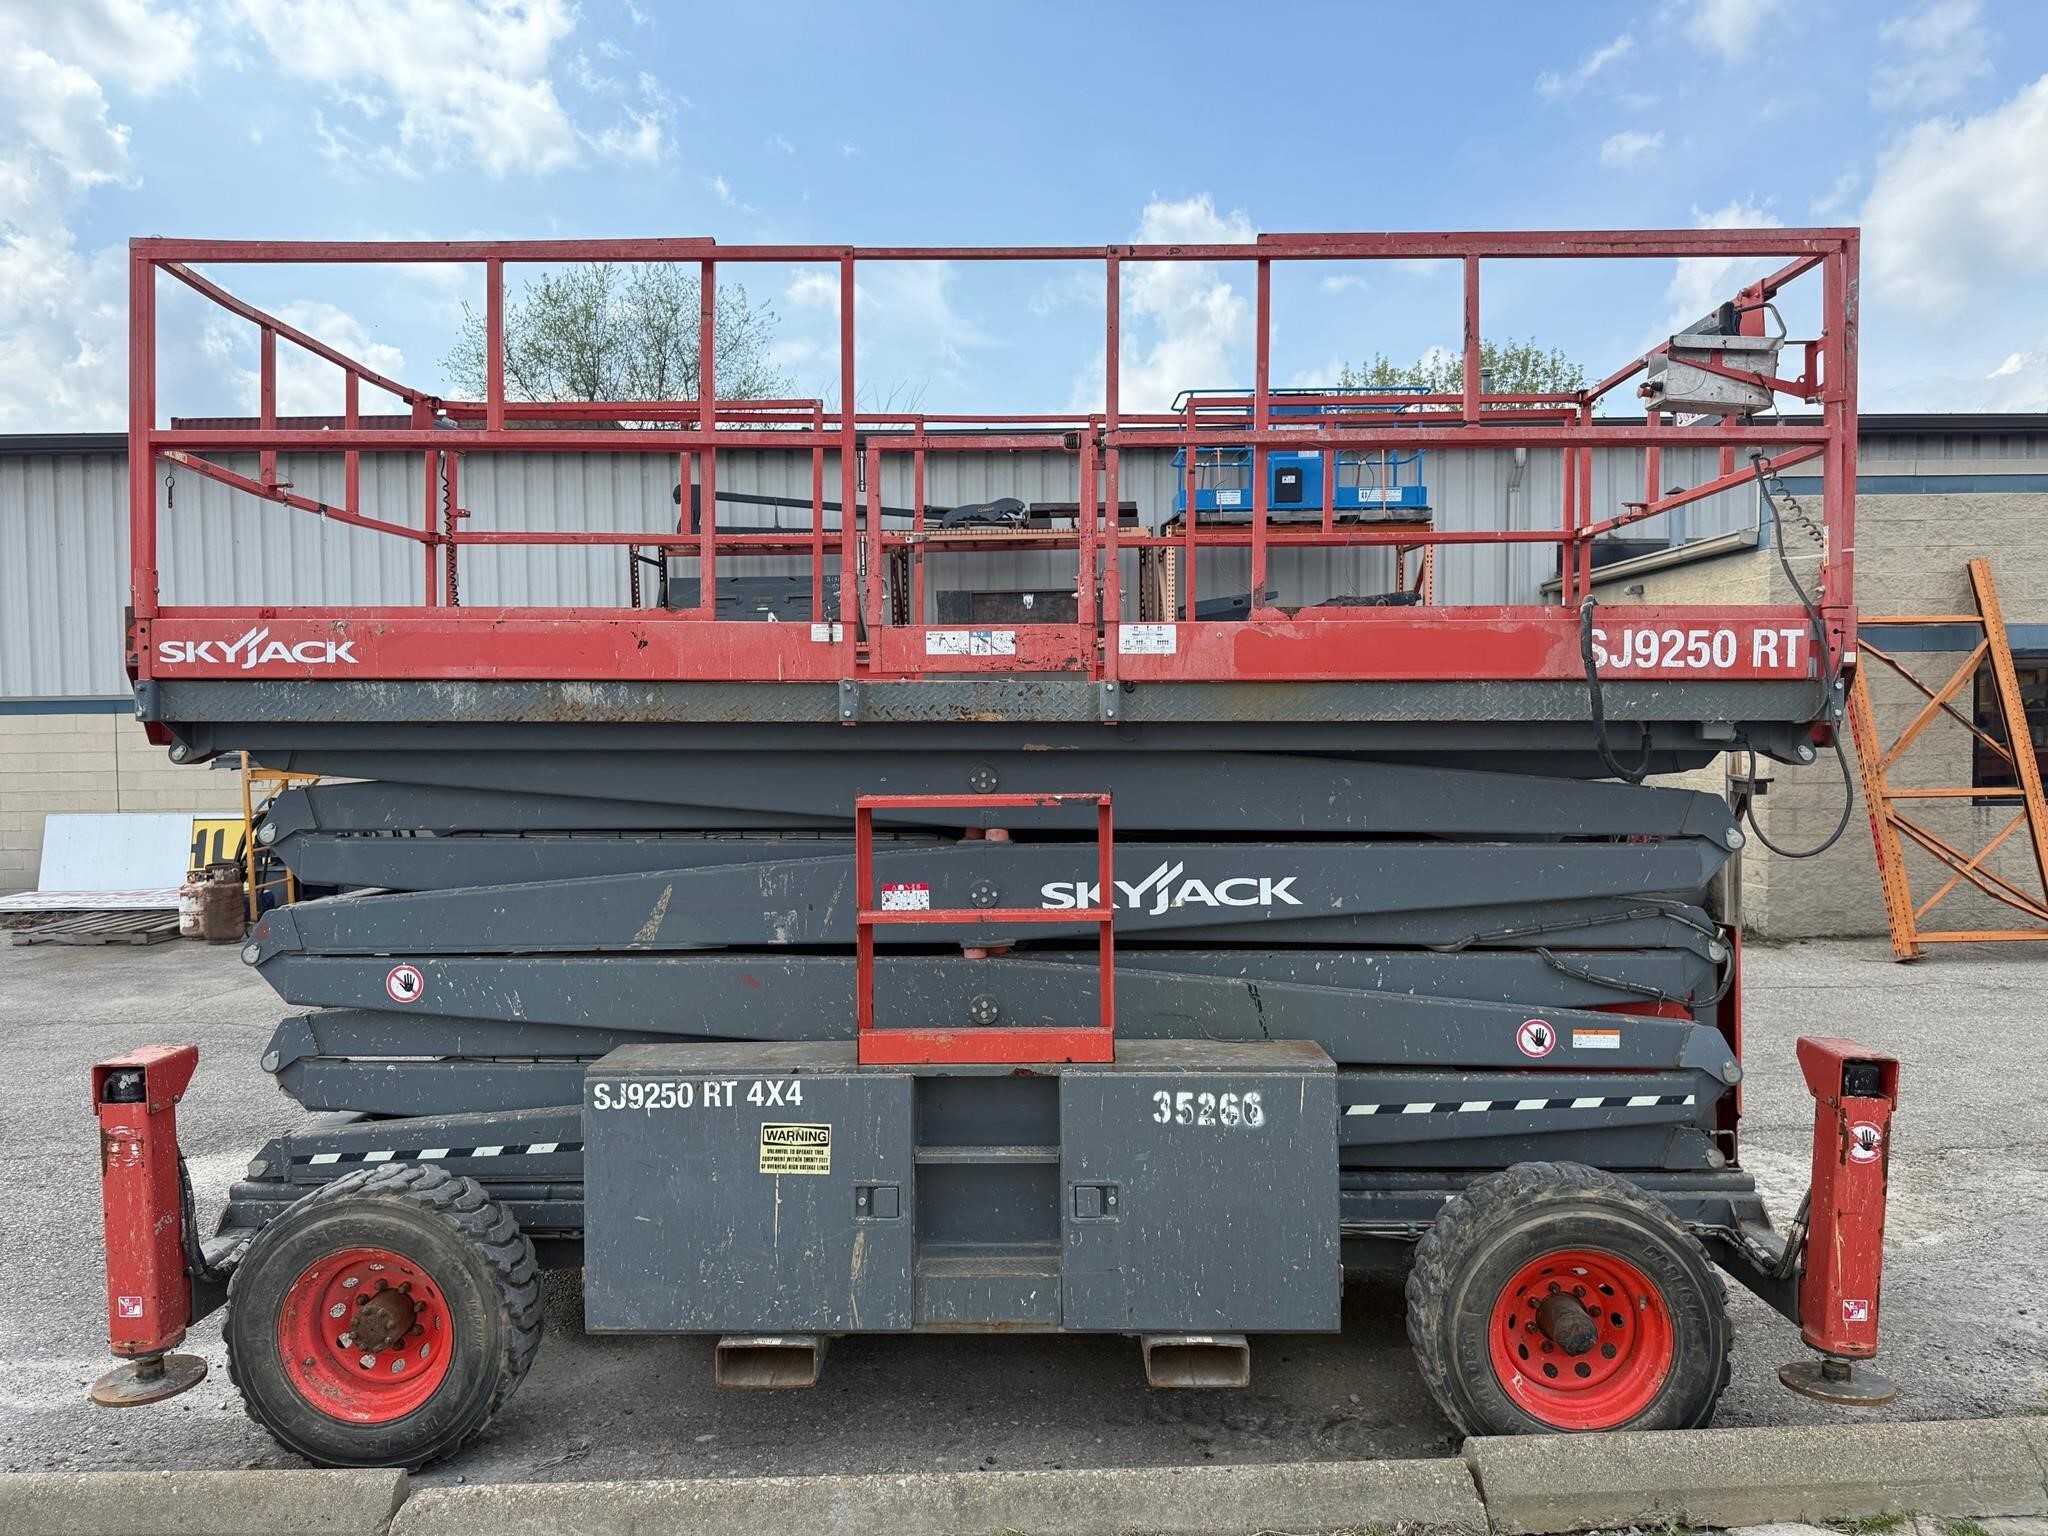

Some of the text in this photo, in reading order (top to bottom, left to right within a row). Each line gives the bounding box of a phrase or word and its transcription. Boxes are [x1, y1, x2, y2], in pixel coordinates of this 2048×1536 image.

[158, 626, 359, 669] SKYJACK
[1591, 628, 1805, 668] SJ9250 RT
[593, 1080, 804, 1110] SJ9250 RT 4X4
[766, 1130, 827, 1142] WARNING
